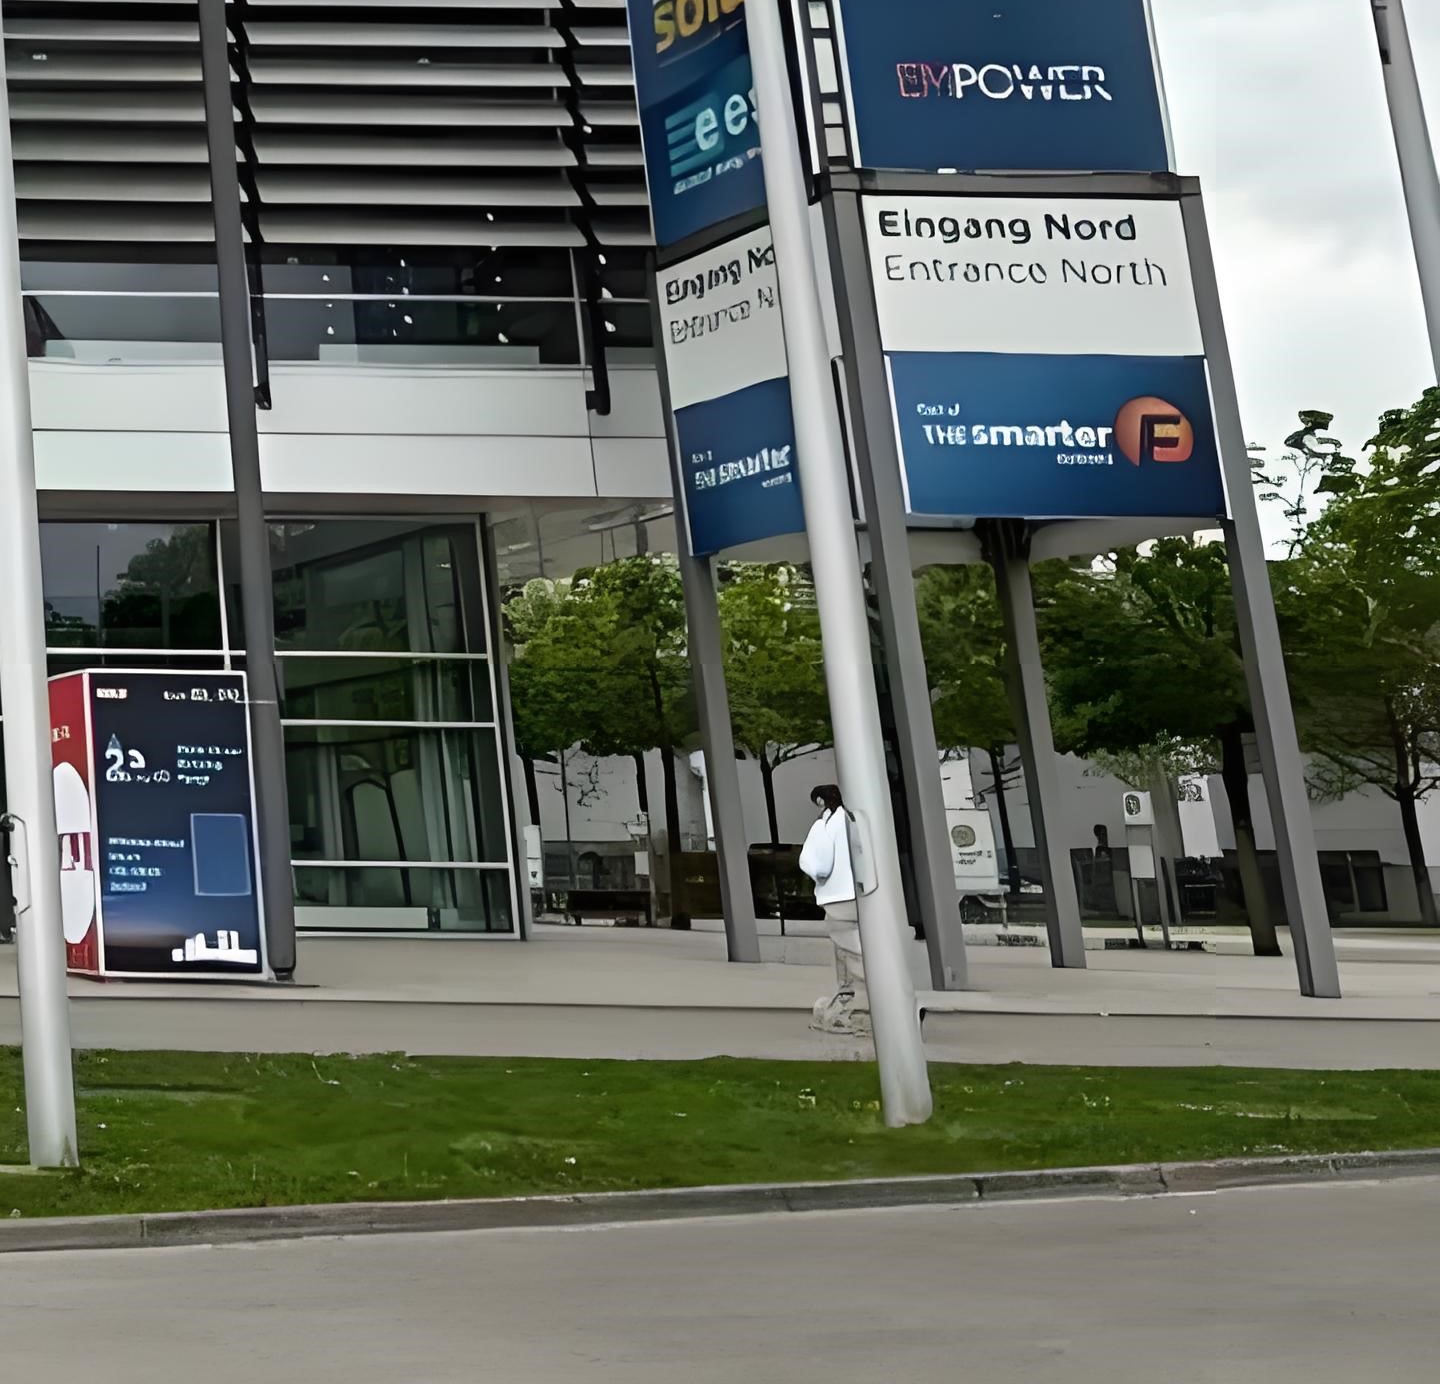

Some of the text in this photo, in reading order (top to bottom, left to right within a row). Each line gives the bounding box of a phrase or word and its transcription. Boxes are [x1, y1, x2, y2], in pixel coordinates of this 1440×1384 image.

[878, 208, 1136, 244] Eingang Nord
[885, 254, 1168, 287] Entrance North
[972, 420, 1113, 448] smarter
